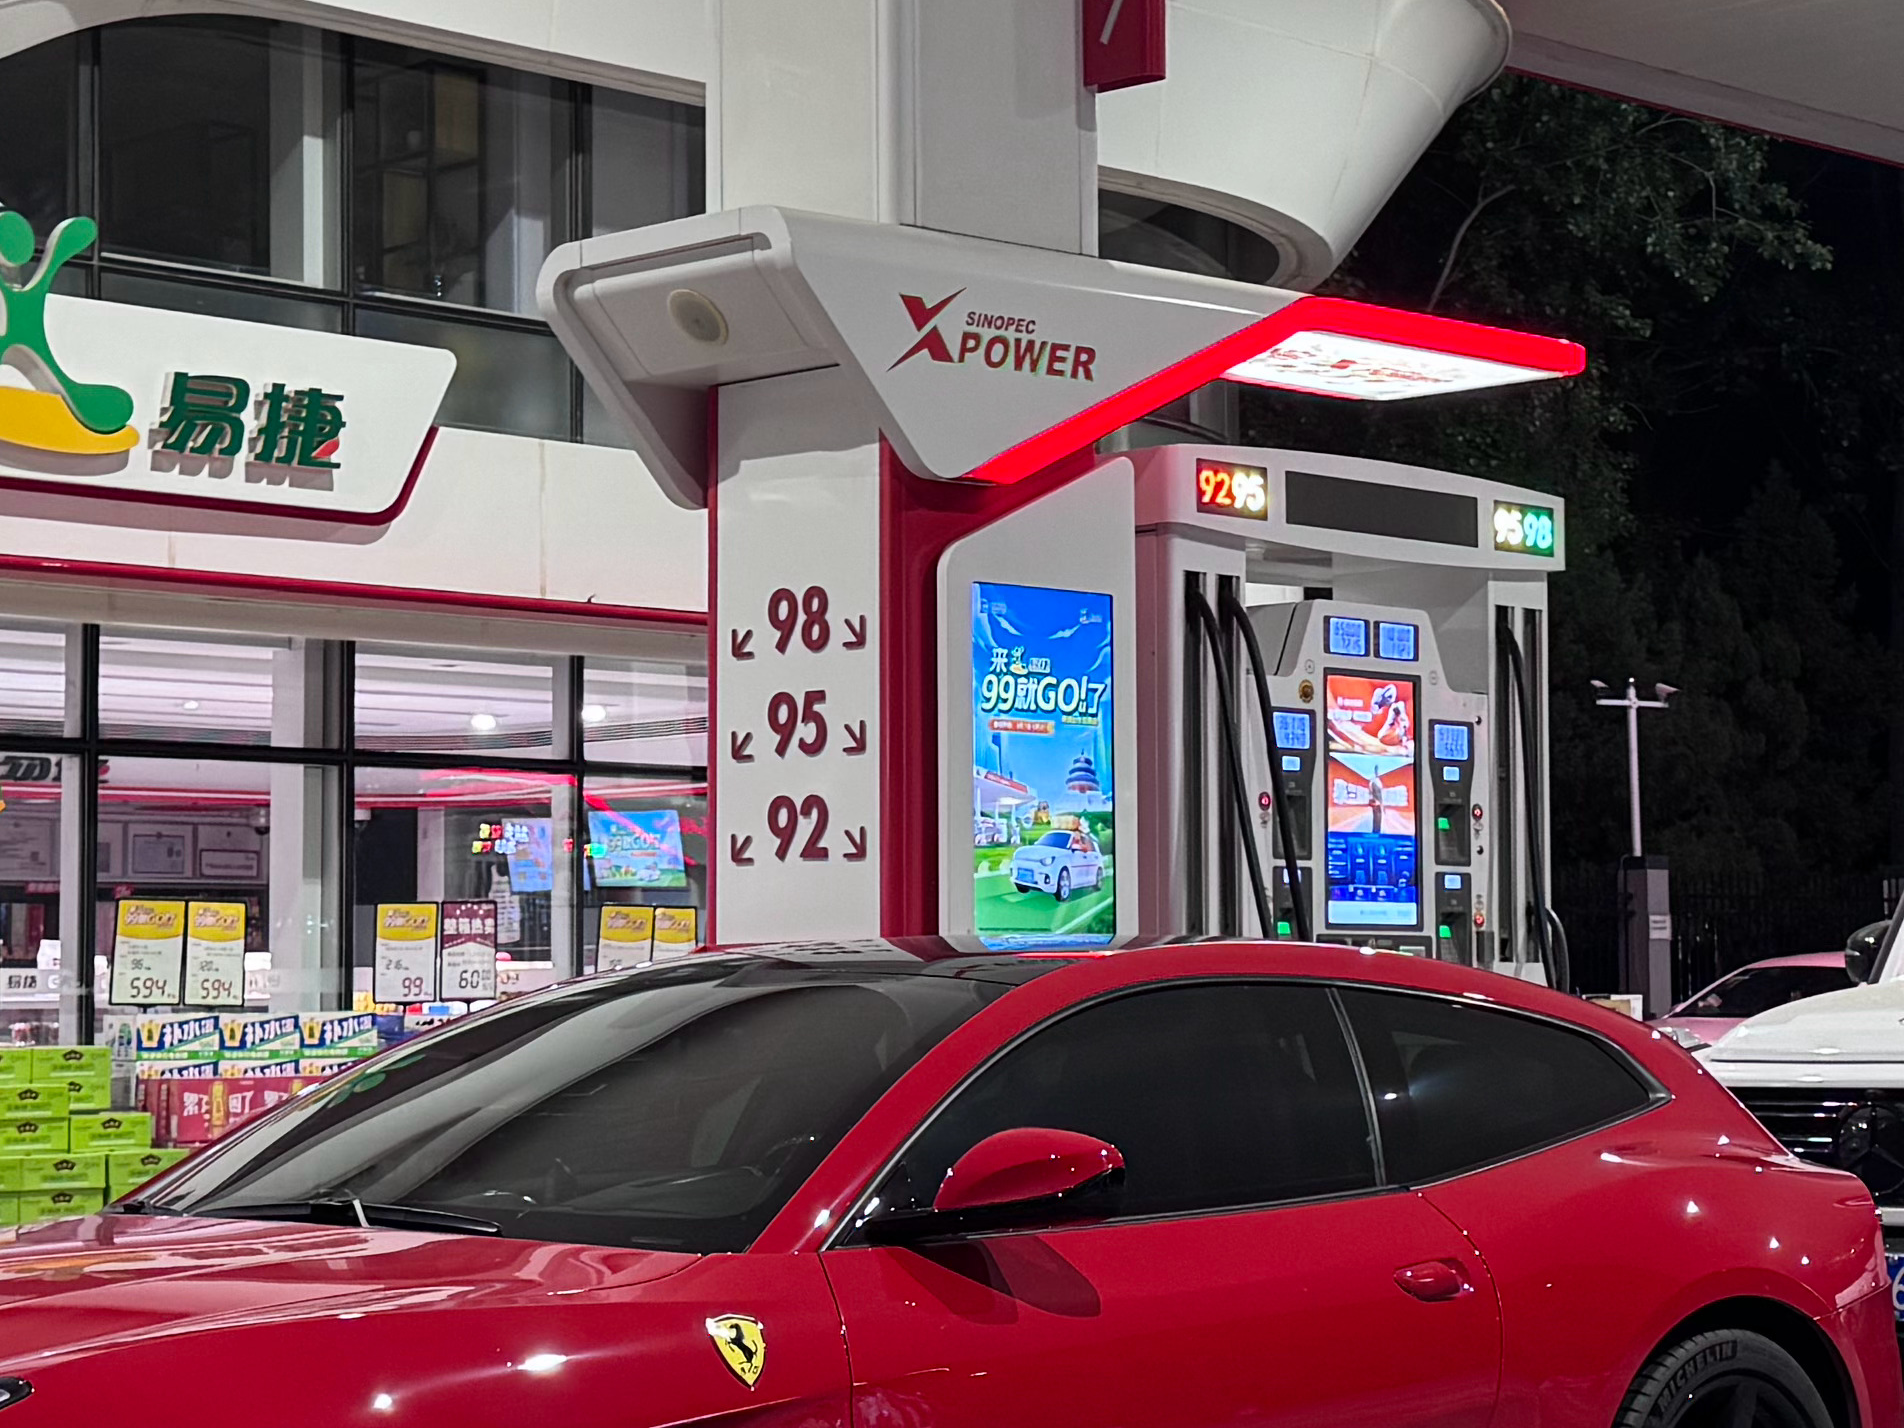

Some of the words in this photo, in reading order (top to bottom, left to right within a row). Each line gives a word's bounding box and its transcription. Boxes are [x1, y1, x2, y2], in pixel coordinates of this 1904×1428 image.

[965, 310, 1036, 336] SINOPEC
[158, 370, 348, 471] 易捷
[1198, 469, 1232, 507] 92
[1231, 472, 1266, 512] 95
[1493, 507, 1523, 545] 95
[1522, 511, 1554, 550] 98
[767, 585, 831, 656] 98
[767, 688, 828, 759] 95
[766, 793, 830, 862] 92
[130, 977, 168, 999] 594
[200, 977, 233, 999] 594
[401, 976, 424, 998] 99
[458, 969, 481, 989] 60
